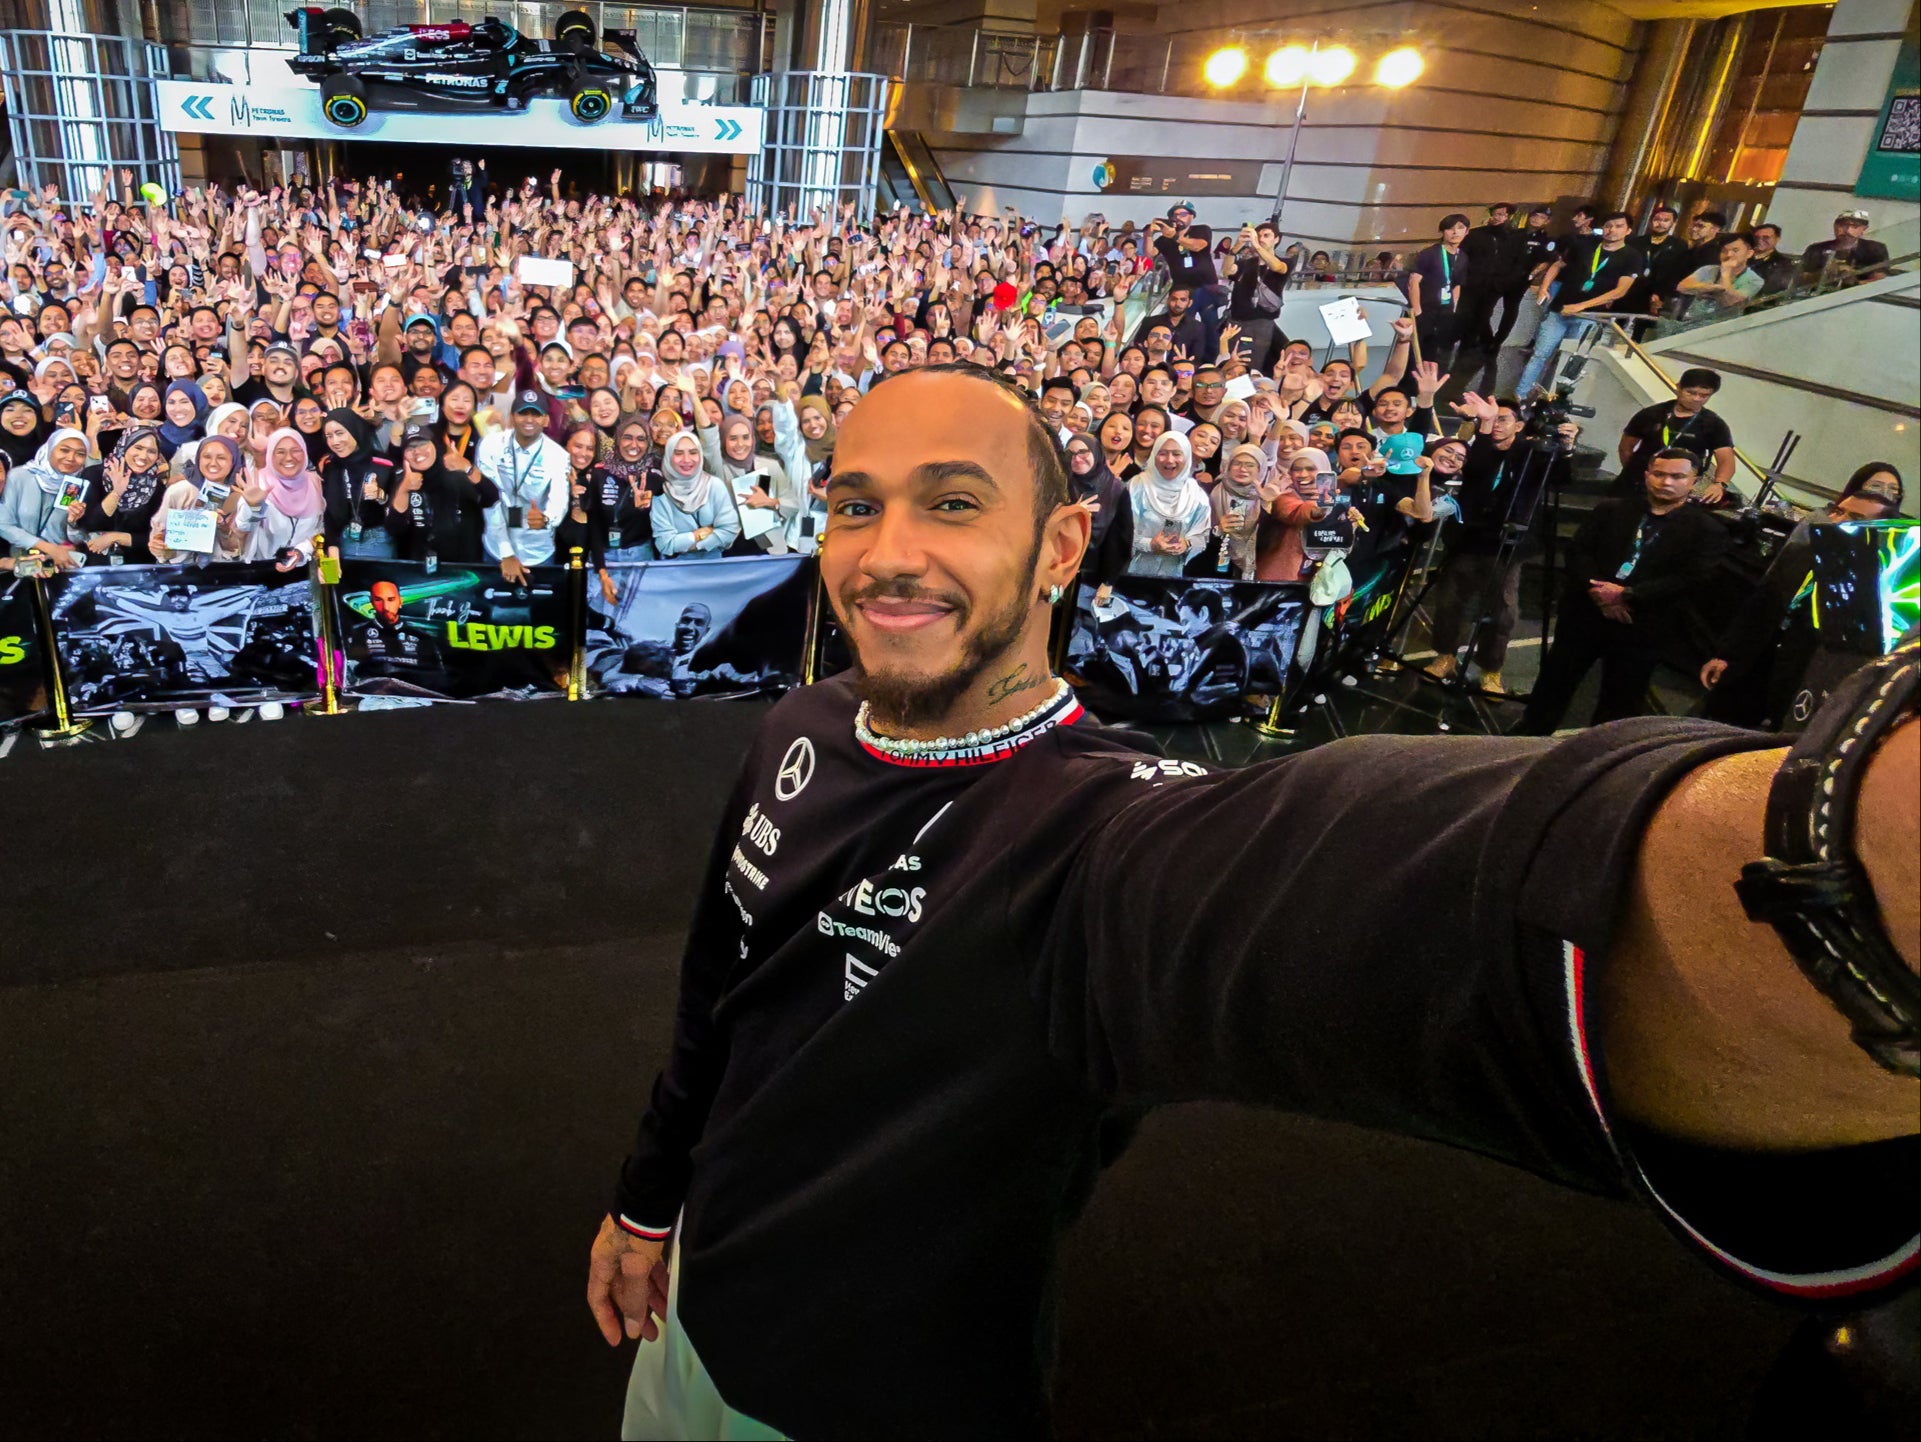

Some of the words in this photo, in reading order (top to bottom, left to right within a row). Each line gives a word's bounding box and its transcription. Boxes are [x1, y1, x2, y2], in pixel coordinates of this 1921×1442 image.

[425, 73, 489, 88] PETRONAS
[446, 620, 556, 651] LEWIS
[750, 813, 781, 856] UBS
